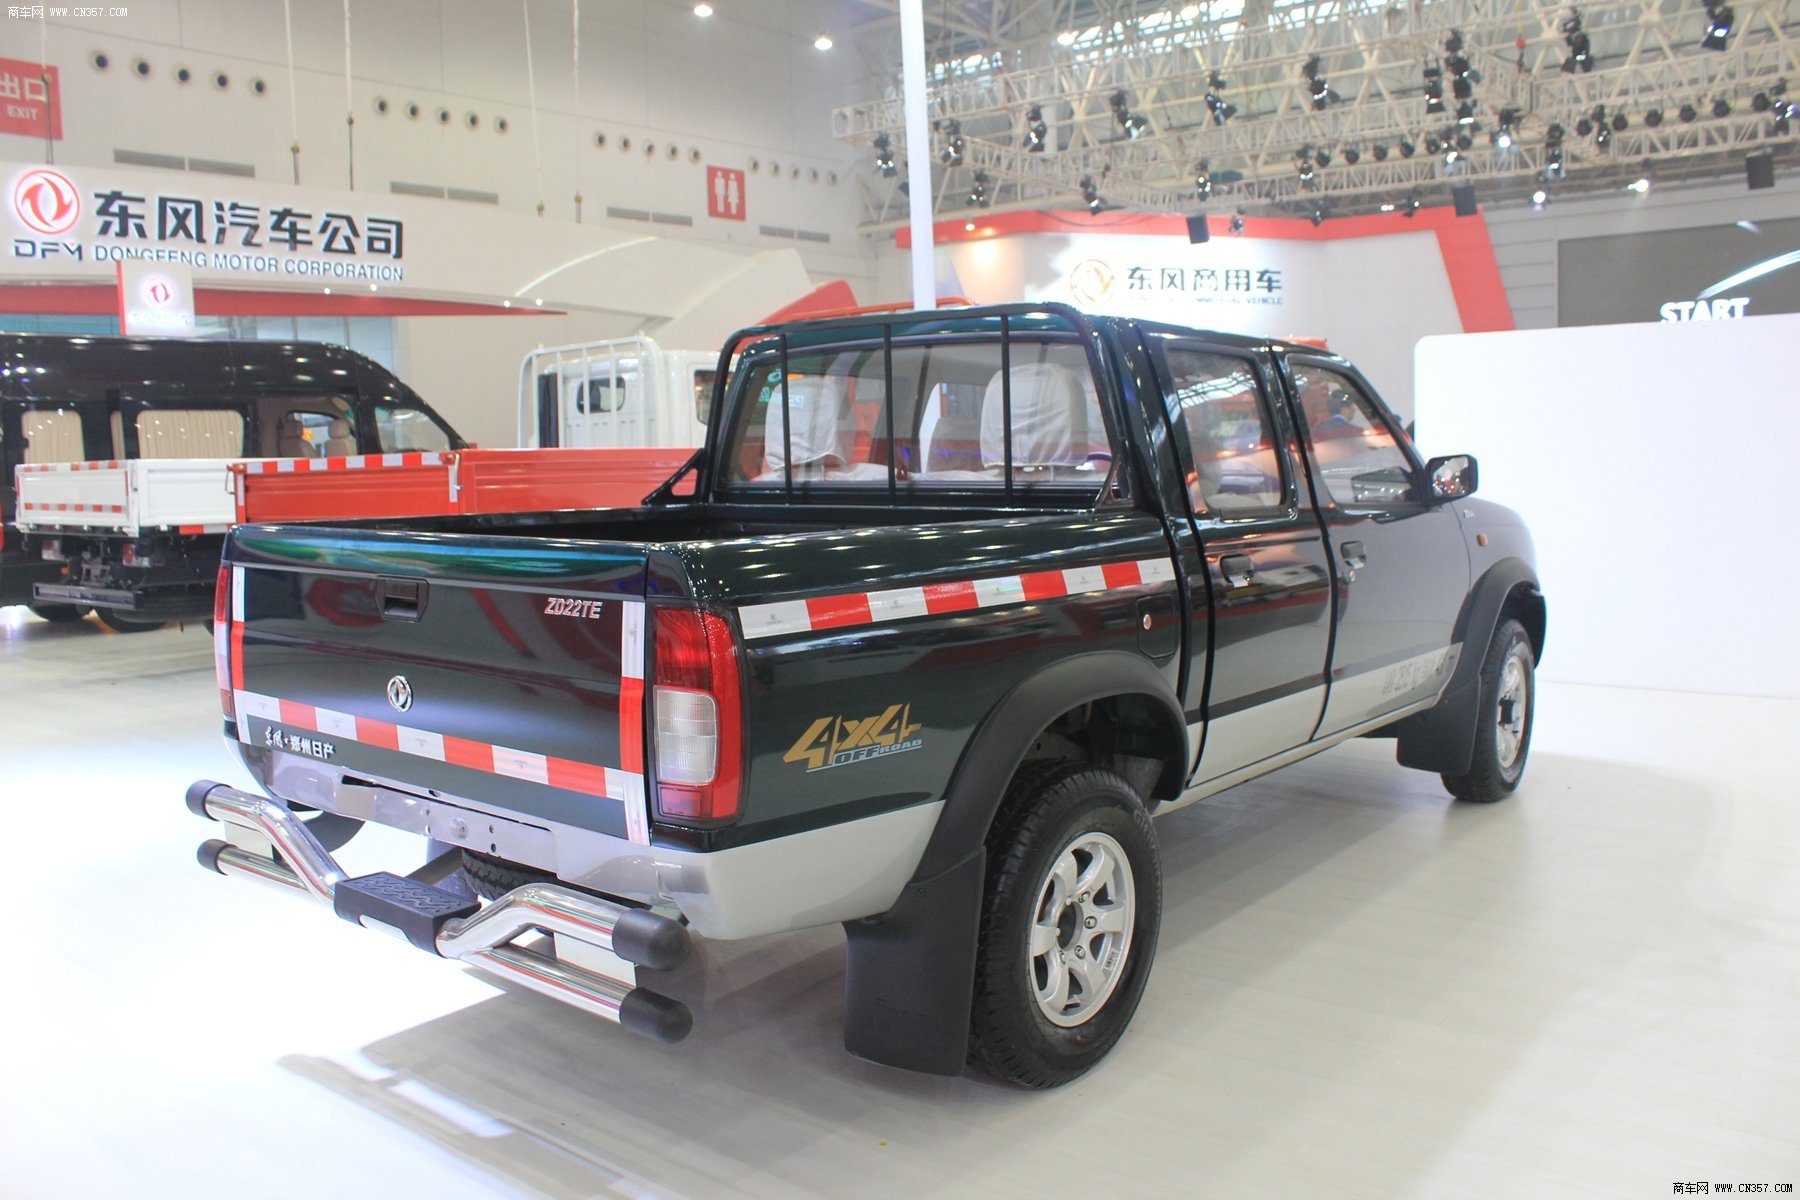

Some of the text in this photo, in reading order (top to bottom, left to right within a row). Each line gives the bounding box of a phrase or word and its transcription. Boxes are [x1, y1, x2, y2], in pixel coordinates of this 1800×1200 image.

[0, 71, 48, 103] 出口
[7, 104, 38, 120] EXIT
[93, 190, 403, 260] 东风汽车公司
[14, 239, 83, 261] DFM
[214, 253, 279, 273] MOTOR
[283, 258, 404, 281] CORPORATION
[1127, 266, 1283, 293] 东风商用车
[1246, 297, 1284, 305] VEHICLE
[1660, 298, 1750, 324] START
[544, 597, 603, 619] ZD22TE
